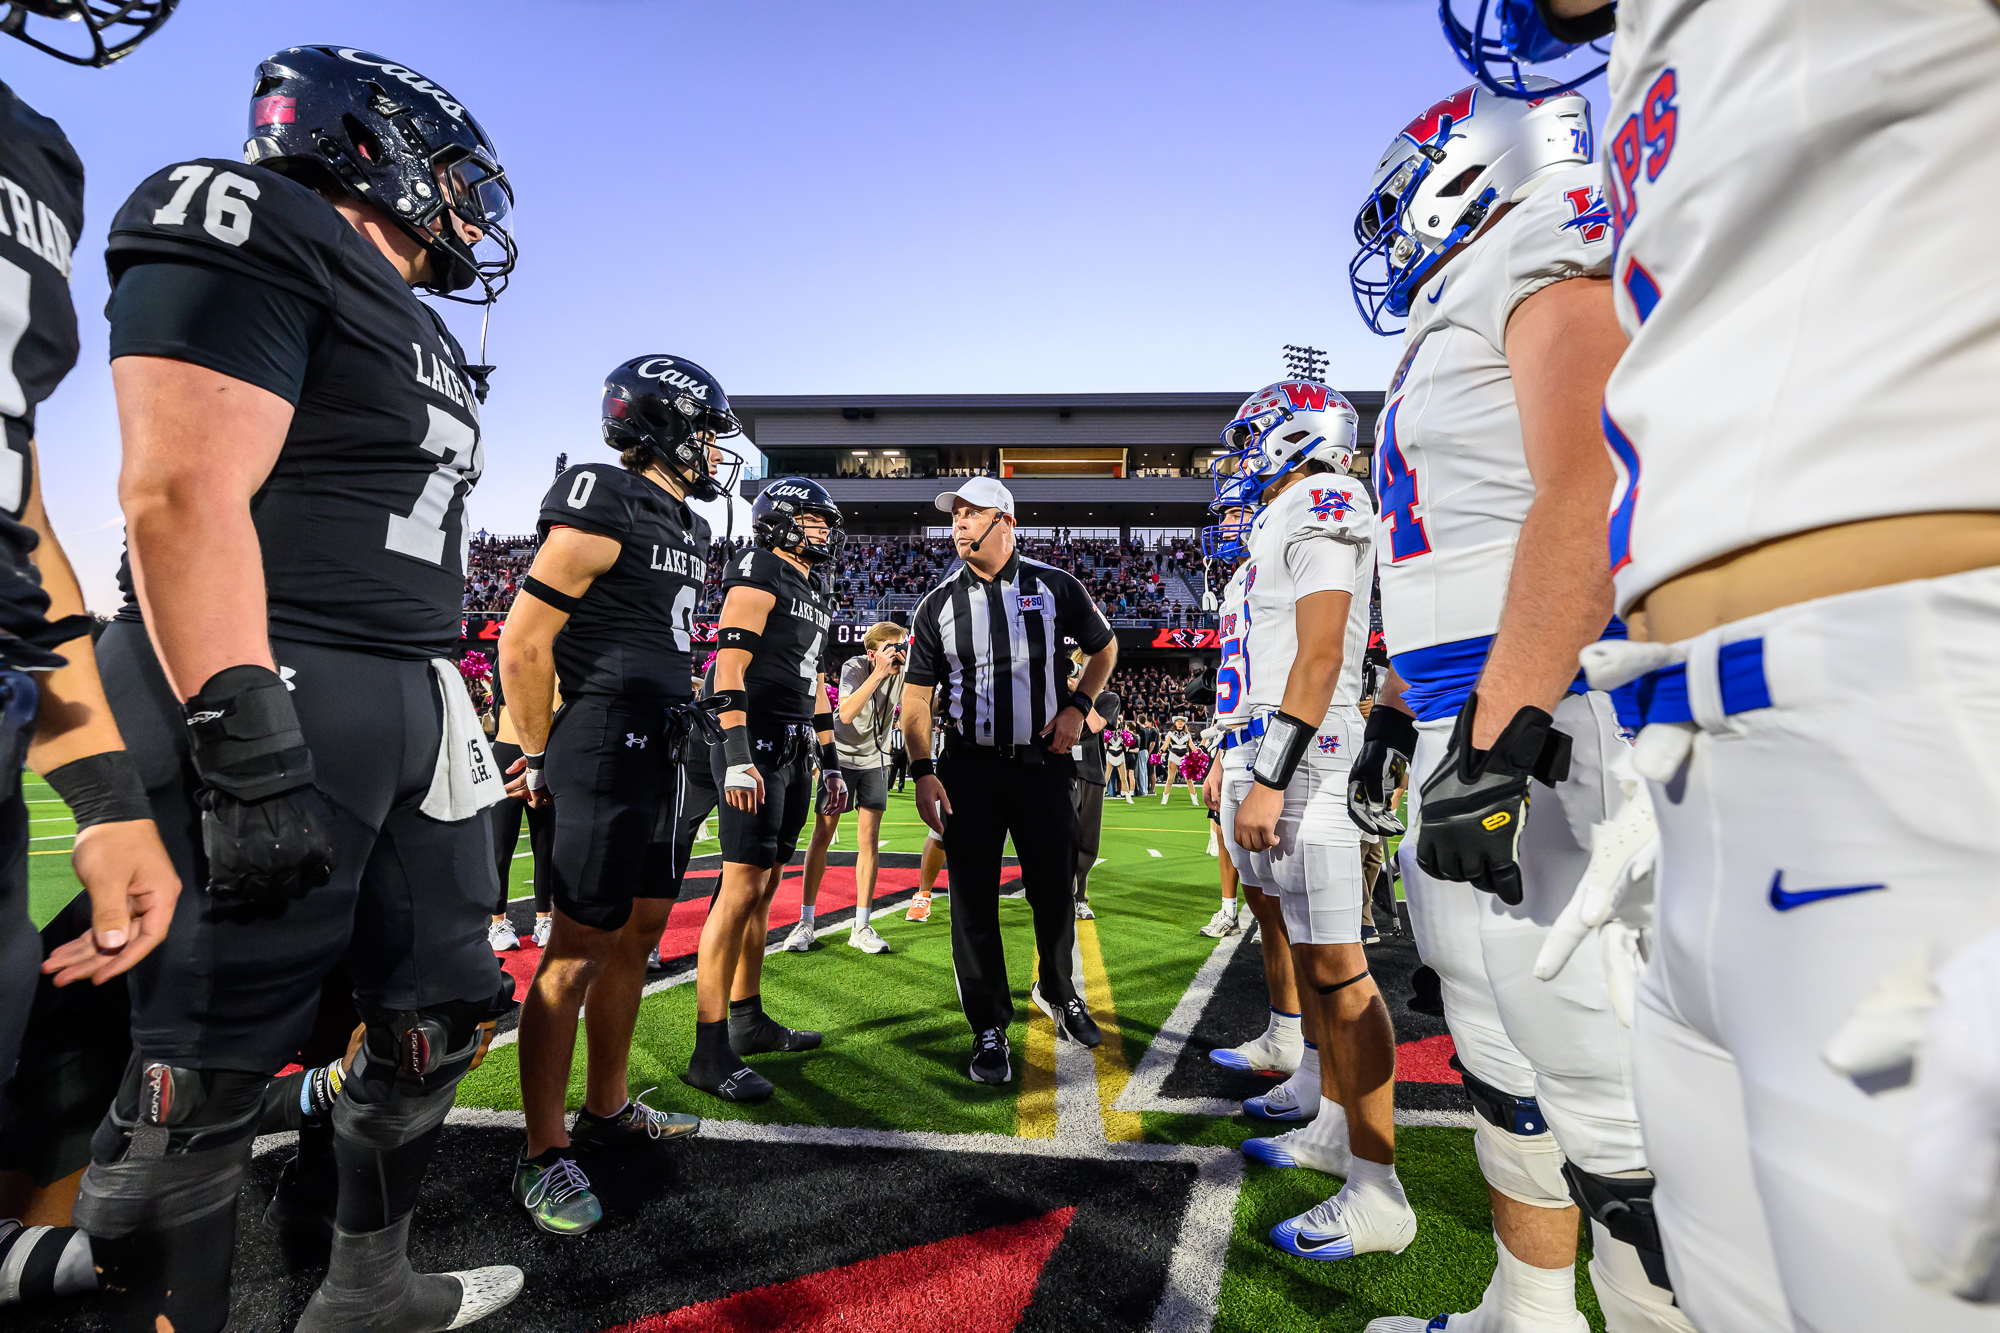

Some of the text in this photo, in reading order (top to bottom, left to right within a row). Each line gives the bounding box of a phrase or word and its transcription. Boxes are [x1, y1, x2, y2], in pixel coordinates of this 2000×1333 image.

[337, 48, 466, 124] Cavs
[1569, 128, 1588, 157] 74
[152, 164, 261, 247] 76
[412, 342, 465, 408] LAKE
[638, 358, 708, 400] Cavs
[1278, 382, 1334, 412] W
[384, 403, 485, 580] 7
[566, 470, 597, 510] 0
[767, 480, 811, 500] Cavs
[1373, 394, 1432, 563] 4
[650, 544, 688, 576] LAKE
[738, 551, 755, 578] 4
[790, 597, 814, 622] LAKE
[838, 625, 850, 643] 0
[1216, 637, 1241, 714] 5
[467, 738, 484, 767] 5
[411, 1033, 420, 1073] DONJOY
